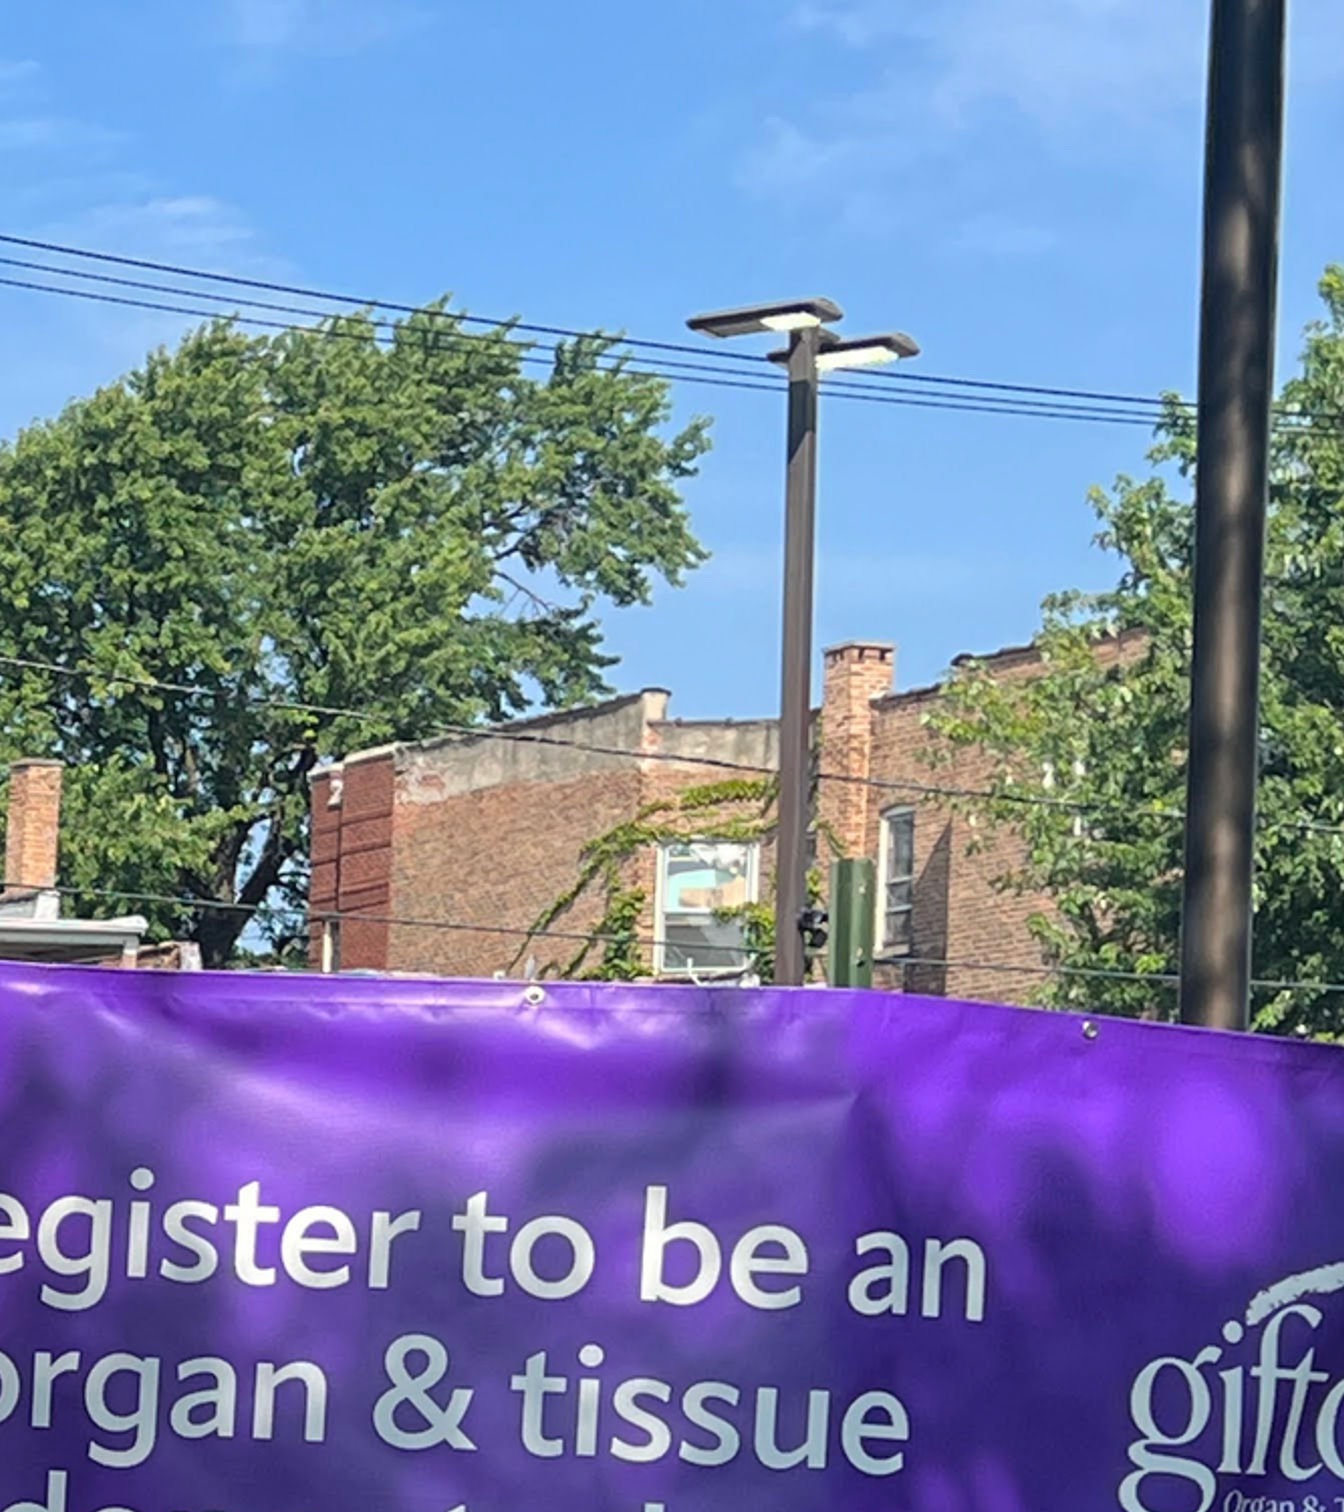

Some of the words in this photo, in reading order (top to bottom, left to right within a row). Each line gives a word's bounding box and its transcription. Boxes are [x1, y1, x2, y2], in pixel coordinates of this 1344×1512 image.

[451, 1190, 596, 1300] to
[639, 1185, 809, 1310] be
[848, 1231, 985, 1322] an
[373, 1334, 478, 1451] &
[510, 1344, 910, 1476] tissue
